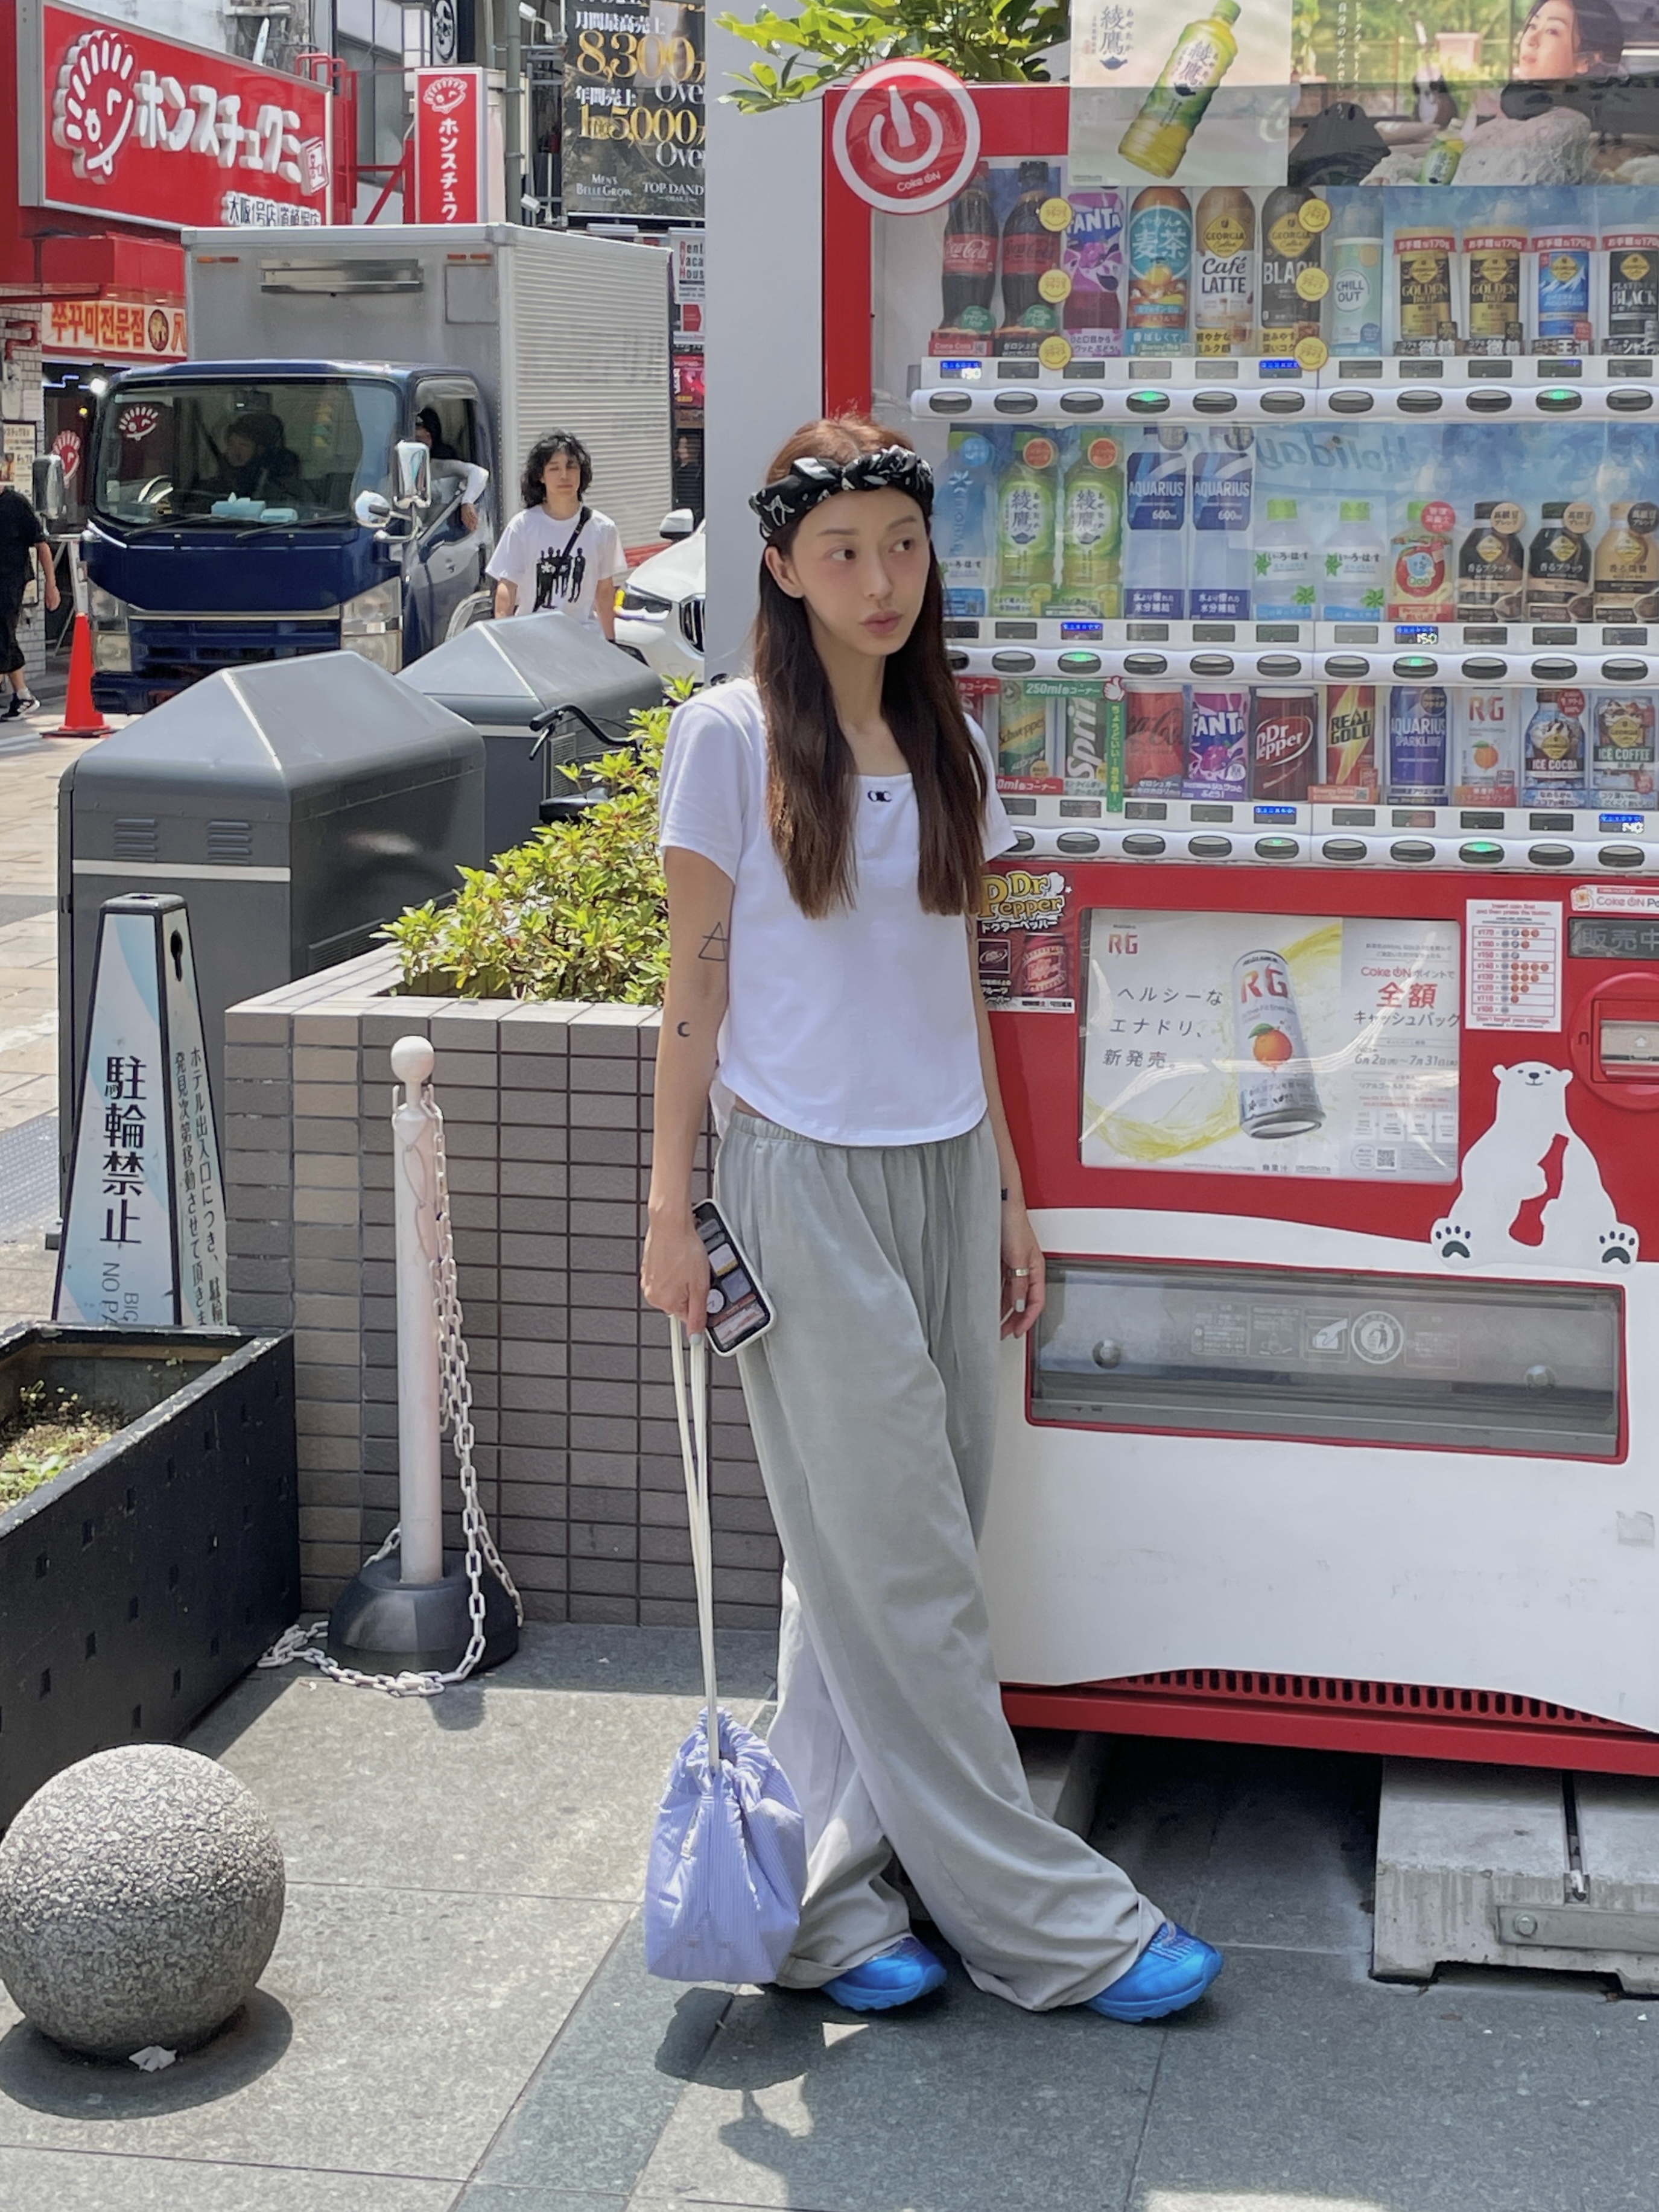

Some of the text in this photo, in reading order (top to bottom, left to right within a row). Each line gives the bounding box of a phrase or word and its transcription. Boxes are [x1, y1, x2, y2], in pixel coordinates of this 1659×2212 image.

[1100, 5, 1125, 55] 綾鷹
[655, 77, 705, 104] Ove
[132, 70, 302, 184] ホンスチュクミ
[438, 118, 460, 221] ホンスチュク
[642, 182, 667, 193] TOP
[1132, 229, 1187, 260] 麦茶
[1202, 258, 1248, 276] Café
[1201, 277, 1246, 294] LATTE
[1336, 280, 1365, 293] CHILL
[1401, 284, 1448, 296] GOLDEN
[1471, 283, 1517, 295] GOLDEN
[1337, 291, 1362, 303] OUT
[1611, 291, 1657, 306] BLACK
[1128, 481, 1184, 496] AQUARIUS
[1194, 481, 1250, 497] AQUARIUS
[1469, 696, 1505, 721] RG
[1191, 711, 1245, 737] FANTA
[1331, 711, 1371, 730] REAL
[1266, 724, 1289, 740] Dr
[1331, 724, 1371, 745] GOLD
[1598, 748, 1651, 761] ICE COFFEE
[1532, 759, 1578, 770] ICE COCOA
[1009, 872, 1048, 897] Dr
[977, 876, 1064, 919] Pepper
[1596, 896, 1645, 907] Coke ON
[982, 919, 1058, 934] ドクターペッパー
[1108, 932, 1138, 955] RG
[1582, 927, 1659, 951] 販売中
[1360, 966, 1391, 977] Coke
[1392, 966, 1412, 978] ON
[1240, 965, 1289, 1004] RG
[1117, 989, 1223, 1007] ヘルシーな
[1376, 981, 1438, 1009] 全額
[1109, 1018, 1202, 1038] エナドリ、
[1353, 1009, 1461, 1028] キャッシュバック
[1102, 1048, 1178, 1070] 新発売。
[99, 1055, 147, 1244] 駐輪禁止
[101, 1262, 120, 1294] NO
